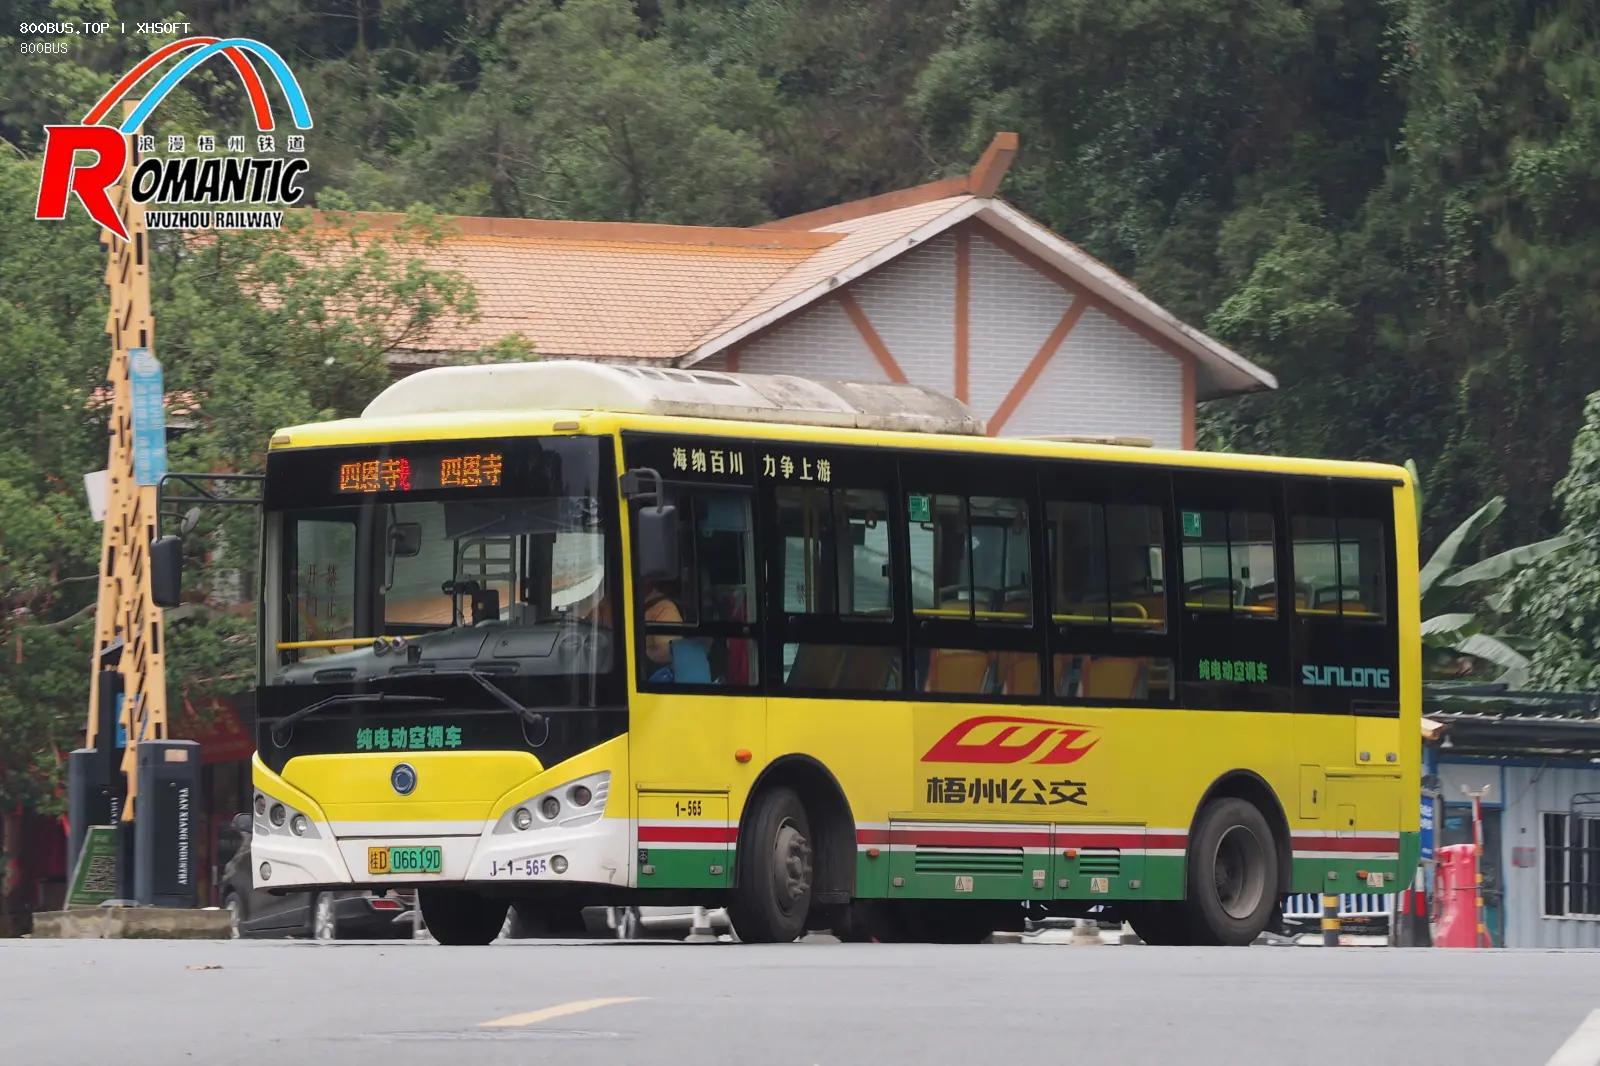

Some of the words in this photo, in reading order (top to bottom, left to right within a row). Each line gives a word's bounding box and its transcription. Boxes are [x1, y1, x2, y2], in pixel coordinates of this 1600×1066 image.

[672, 447, 744, 475] 海纳百川
[763, 454, 831, 482] 力争上游
[1199, 658, 1268, 682] 纯电动空调车
[1302, 665, 1390, 688] SUNLONG
[356, 725, 462, 750] 纯电动空调车
[926, 776, 1088, 806] 梧州公交
[675, 800, 702, 817] 1-565
[178, 812, 189, 840] XIANG
[178, 842, 189, 885] INDUSTRY
[490, 860, 546, 877] J-1-565
